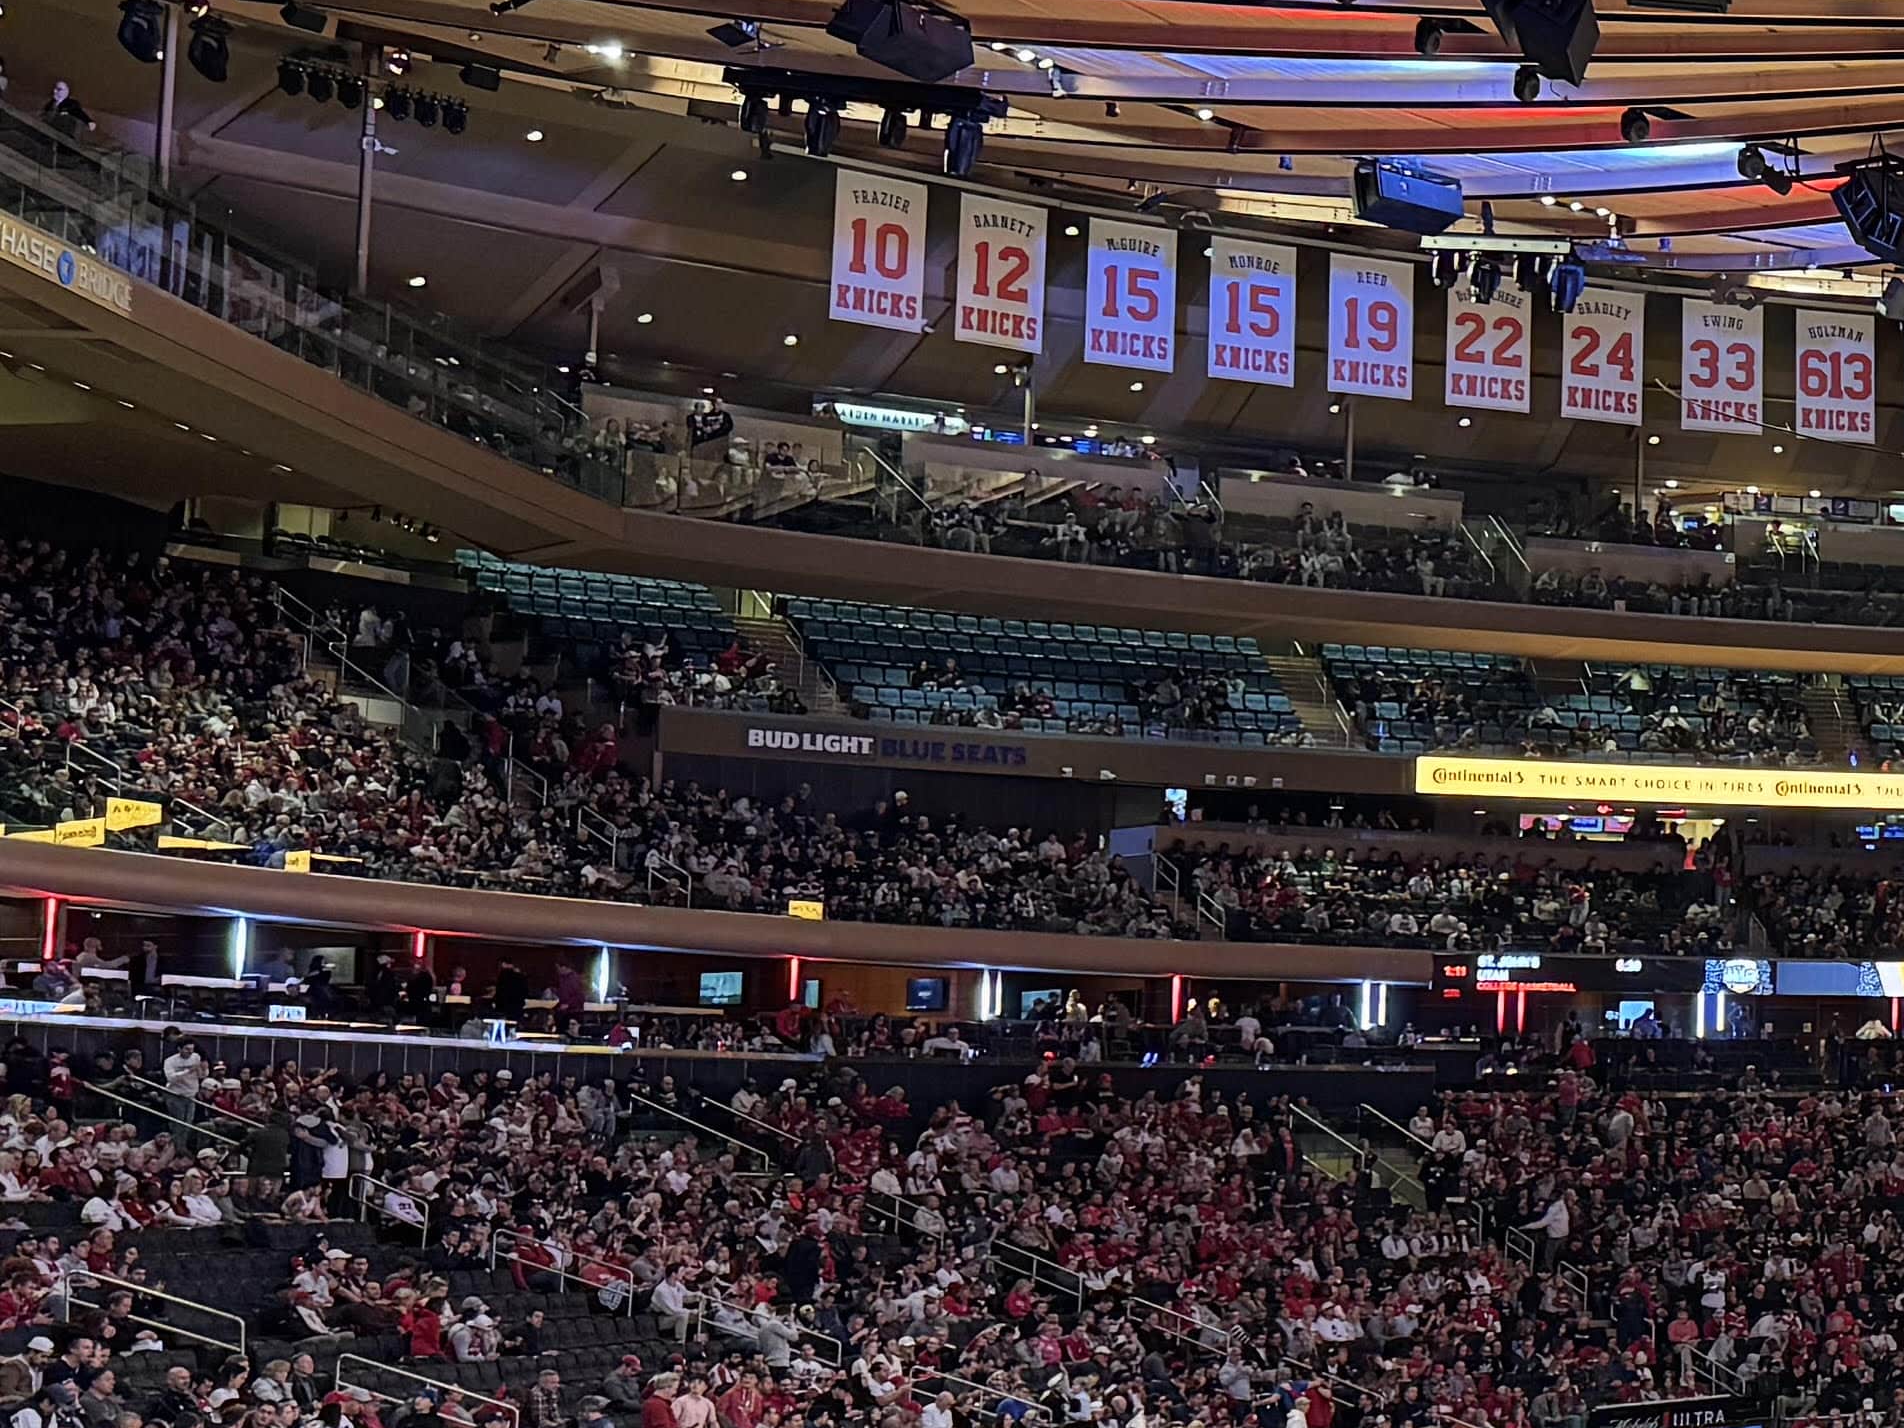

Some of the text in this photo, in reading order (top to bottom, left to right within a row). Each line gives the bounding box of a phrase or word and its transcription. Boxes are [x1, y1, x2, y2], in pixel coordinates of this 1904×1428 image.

[852, 189, 911, 215] FRAZIER
[973, 213, 1036, 239] BARNETT
[849, 218, 909, 280] 10
[1228, 254, 1281, 275] MONROE
[972, 241, 1031, 304] 12
[1356, 270, 1389, 289] REED
[836, 282, 918, 321] KNICKS
[1102, 265, 1160, 323] 15
[1225, 281, 1281, 338] 15
[961, 305, 1038, 342] KNICKS
[1344, 297, 1399, 353] 19
[1577, 301, 1632, 322] BRADLEY
[1703, 314, 1745, 331] EWING
[1090, 328, 1169, 361] KNICKS
[1454, 312, 1523, 369] 22
[1808, 324, 1864, 344] HOLZMAN
[1215, 344, 1290, 376] KNICKS
[1570, 326, 1635, 382] 24
[1689, 338, 1756, 392] 33
[1333, 359, 1408, 389] KNICKS
[1451, 373, 1526, 401] KNICKS
[1799, 348, 1873, 401] 613
[1566, 386, 1638, 415] KNICKS
[1801, 407, 1872, 433] KNICKS
[748, 728, 1027, 767] BUD LIGHT BLUE SEATS
[1575, 775, 1626, 787] SMART
[1634, 778, 1691, 791] CHOICE
[1673, 1409, 1726, 1427] ULTRA
